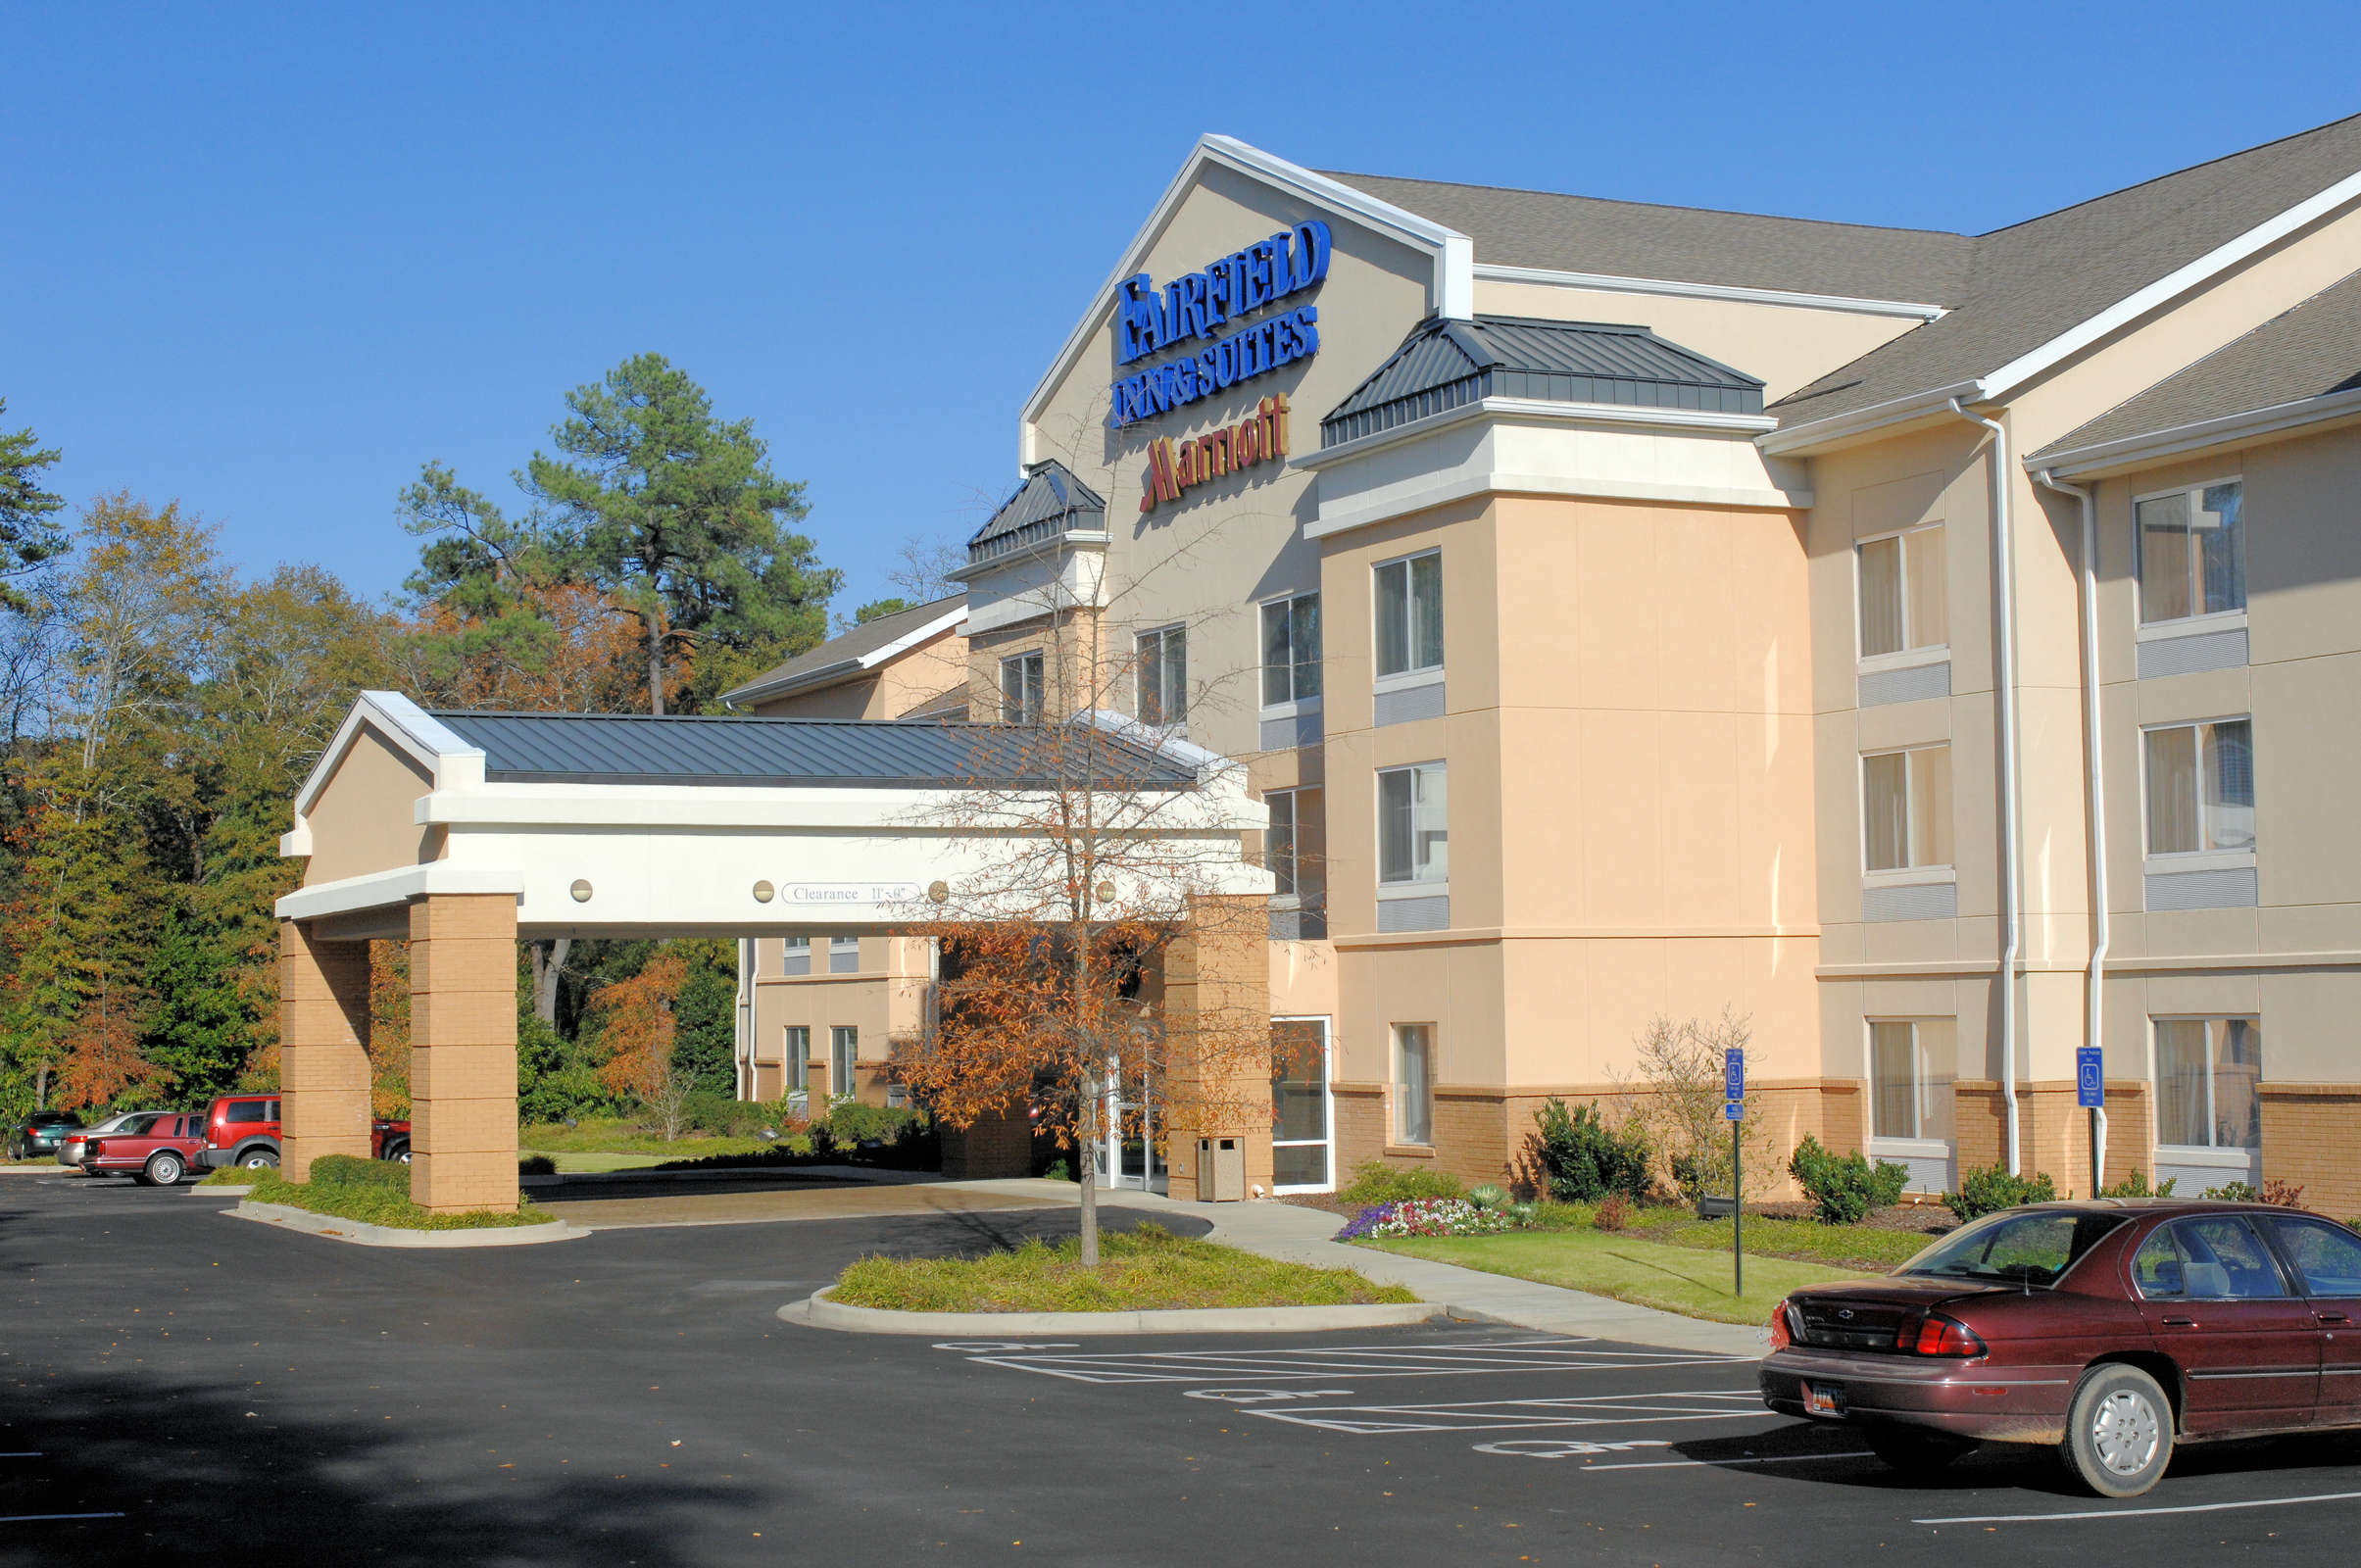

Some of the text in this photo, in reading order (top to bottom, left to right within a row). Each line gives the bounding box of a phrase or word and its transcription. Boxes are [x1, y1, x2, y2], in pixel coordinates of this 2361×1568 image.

[1115, 220, 1332, 366] FAIRFIELD
[1139, 391, 1290, 513] Marriott
[793, 886, 859, 901] Clearance
